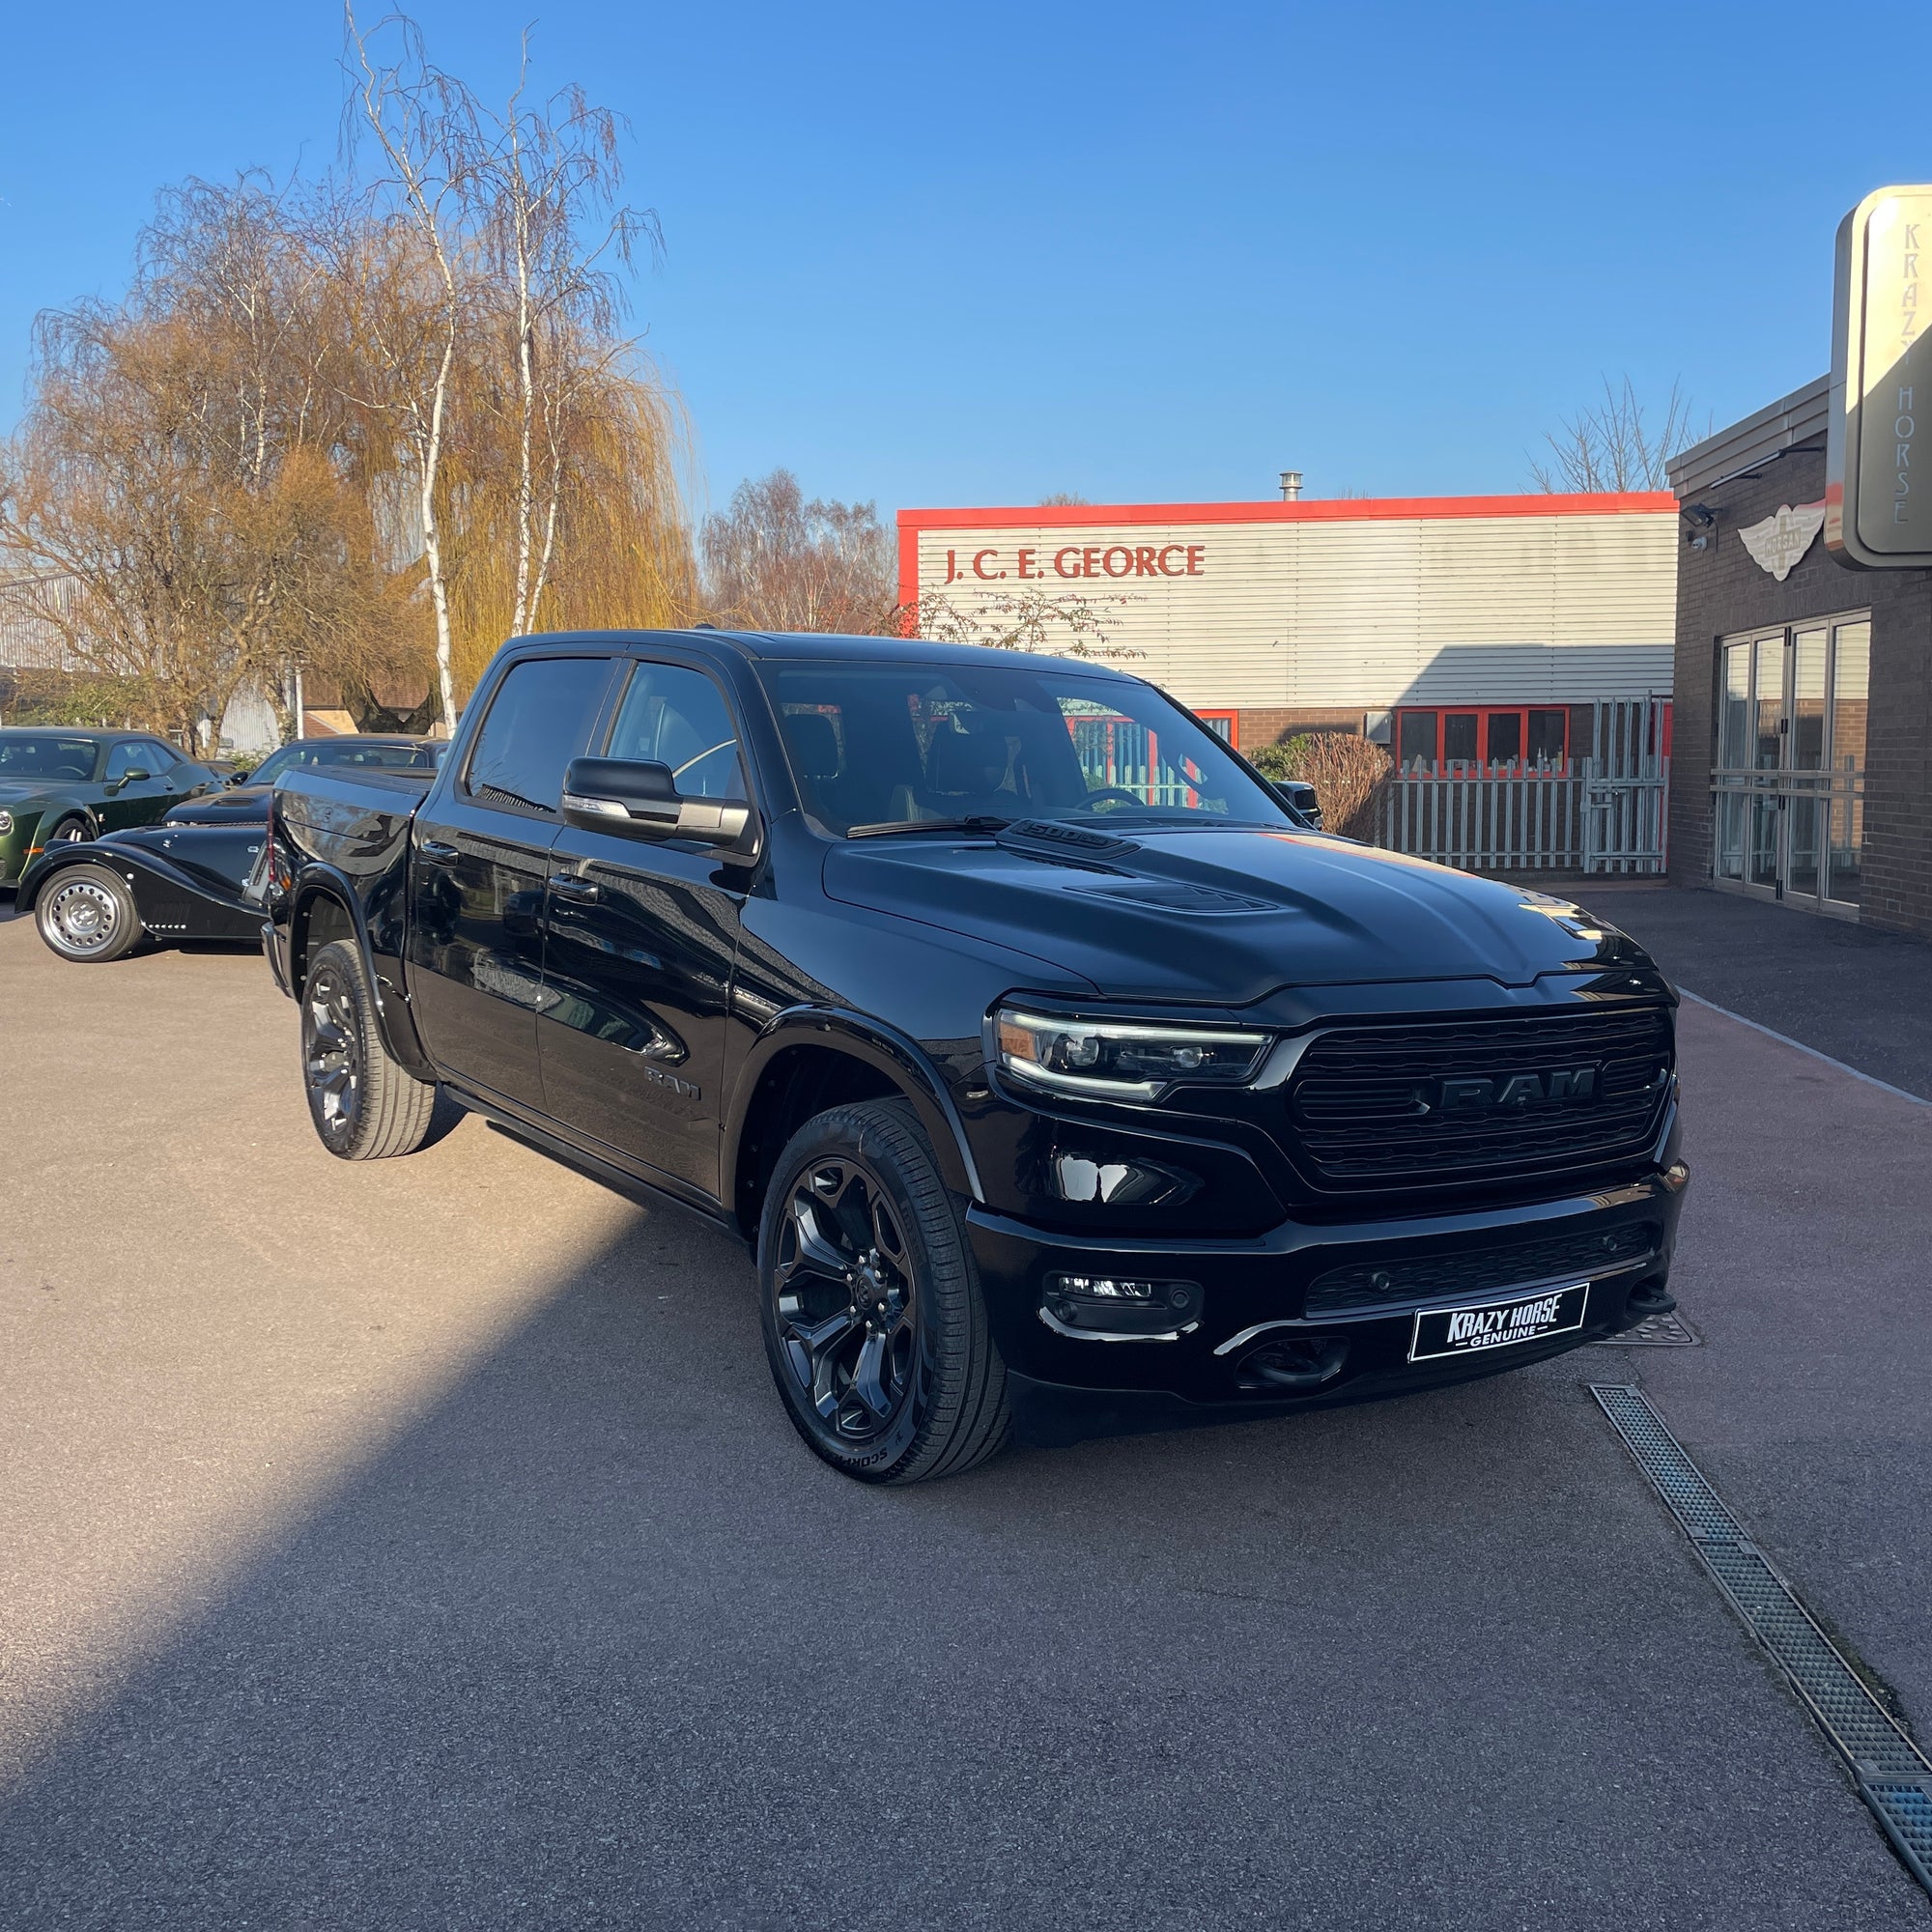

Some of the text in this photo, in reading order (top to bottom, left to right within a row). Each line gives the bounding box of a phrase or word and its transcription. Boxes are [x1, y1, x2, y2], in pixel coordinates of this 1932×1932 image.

[1894, 224, 1920, 524] KRAZY HORSE
[1766, 530, 1801, 557] MORGAN
[944, 550, 964, 584] J.
[973, 549, 1007, 581] C.
[1018, 549, 1044, 580] E.
[645, 1065, 702, 1101] RAM
[1440, 1067, 1596, 1108] RAM
[1447, 1293, 1563, 1343] KRAZY HORSE
[1469, 1325, 1537, 1348] GENUINE
